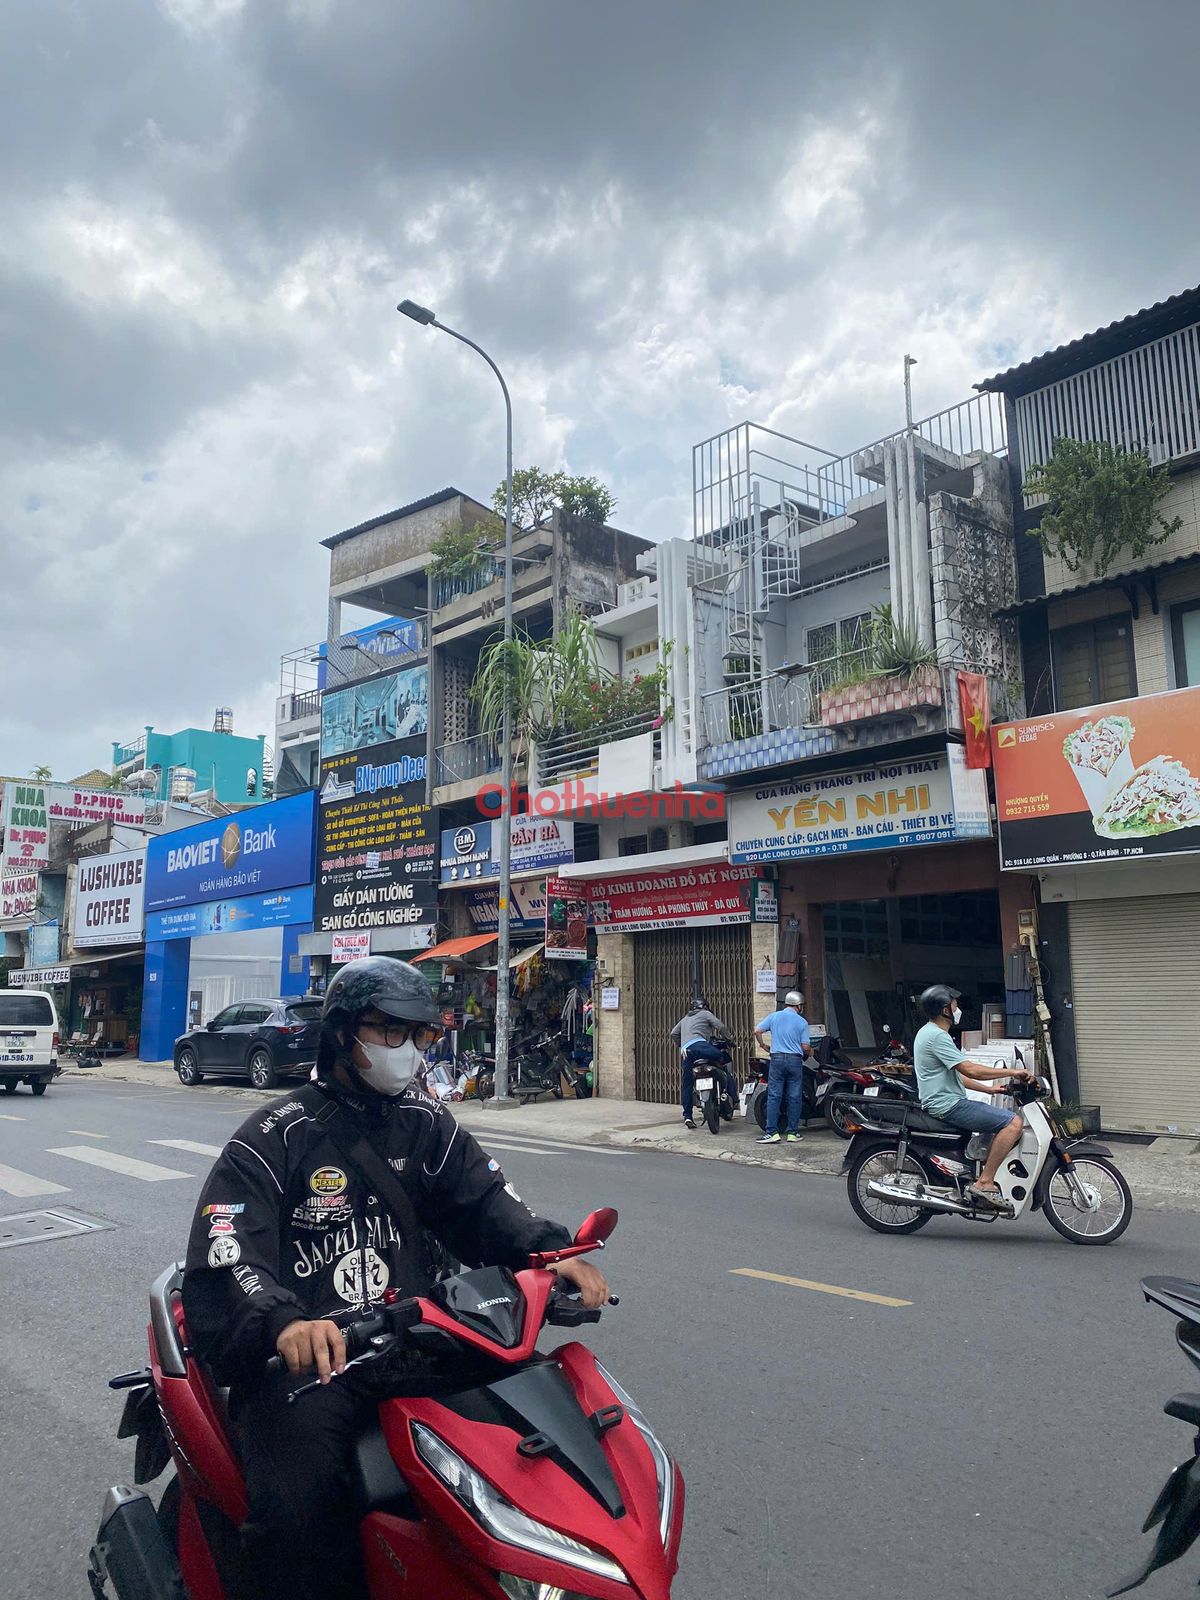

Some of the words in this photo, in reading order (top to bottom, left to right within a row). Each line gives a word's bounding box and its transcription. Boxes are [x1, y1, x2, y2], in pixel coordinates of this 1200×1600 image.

[1018, 721, 1056, 735] SUNRISES
[1018, 733, 1038, 743] KEBAB
[355, 764, 402, 794] BNgroup
[814, 774, 853, 791] TRANG
[15, 786, 45, 807] NHA
[768, 794, 847, 831] YẾN
[856, 784, 931, 820] NHI
[1006, 806, 1023, 817] 0932
[1023, 804, 1036, 815] 715
[1037, 803, 1051, 813] 559
[11, 807, 47, 828] KHOA
[765, 836, 785, 847] CUNG
[807, 831, 829, 844] GẠCH
[831, 828, 849, 839] MEN
[929, 815, 940, 828] BỊ
[167, 838, 219, 872] BAOVIET
[243, 824, 277, 855] Bank
[758, 852, 772, 862] LẠC
[772, 850, 790, 859] LONG
[790, 847, 810, 856] QUÂN
[1032, 856, 1045, 864] LONG
[1045, 854, 1059, 863] QUÂN
[81, 859, 144, 892] LUSHVIBE
[216, 878, 233, 890] HÀNG
[246, 870, 262, 885] VIỆT
[591, 885, 607, 899] HỘ
[608, 883, 634, 896] KINH
[637, 877, 677, 893] DOANH
[679, 870, 697, 887] ĐỒ
[2, 880, 17, 895] NHA
[17, 876, 37, 893] KHOA
[333, 886, 354, 907] GIẤY
[356, 886, 377, 905] DÁN
[378, 881, 414, 902] TƯỜNG
[86, 898, 131, 927] COFFEE
[668, 901, 691, 914] PHONG
[357, 908, 385, 927] CÔNG
[9, 971, 43, 984] LUSHVIBE
[44, 967, 70, 982] COFFEE
[315, 1178, 342, 1186] NEXTEL
[215, 1203, 245, 1213] NASCAR
[292, 1207, 329, 1223] SKF
[476, 1297, 512, 1310] HONDA
